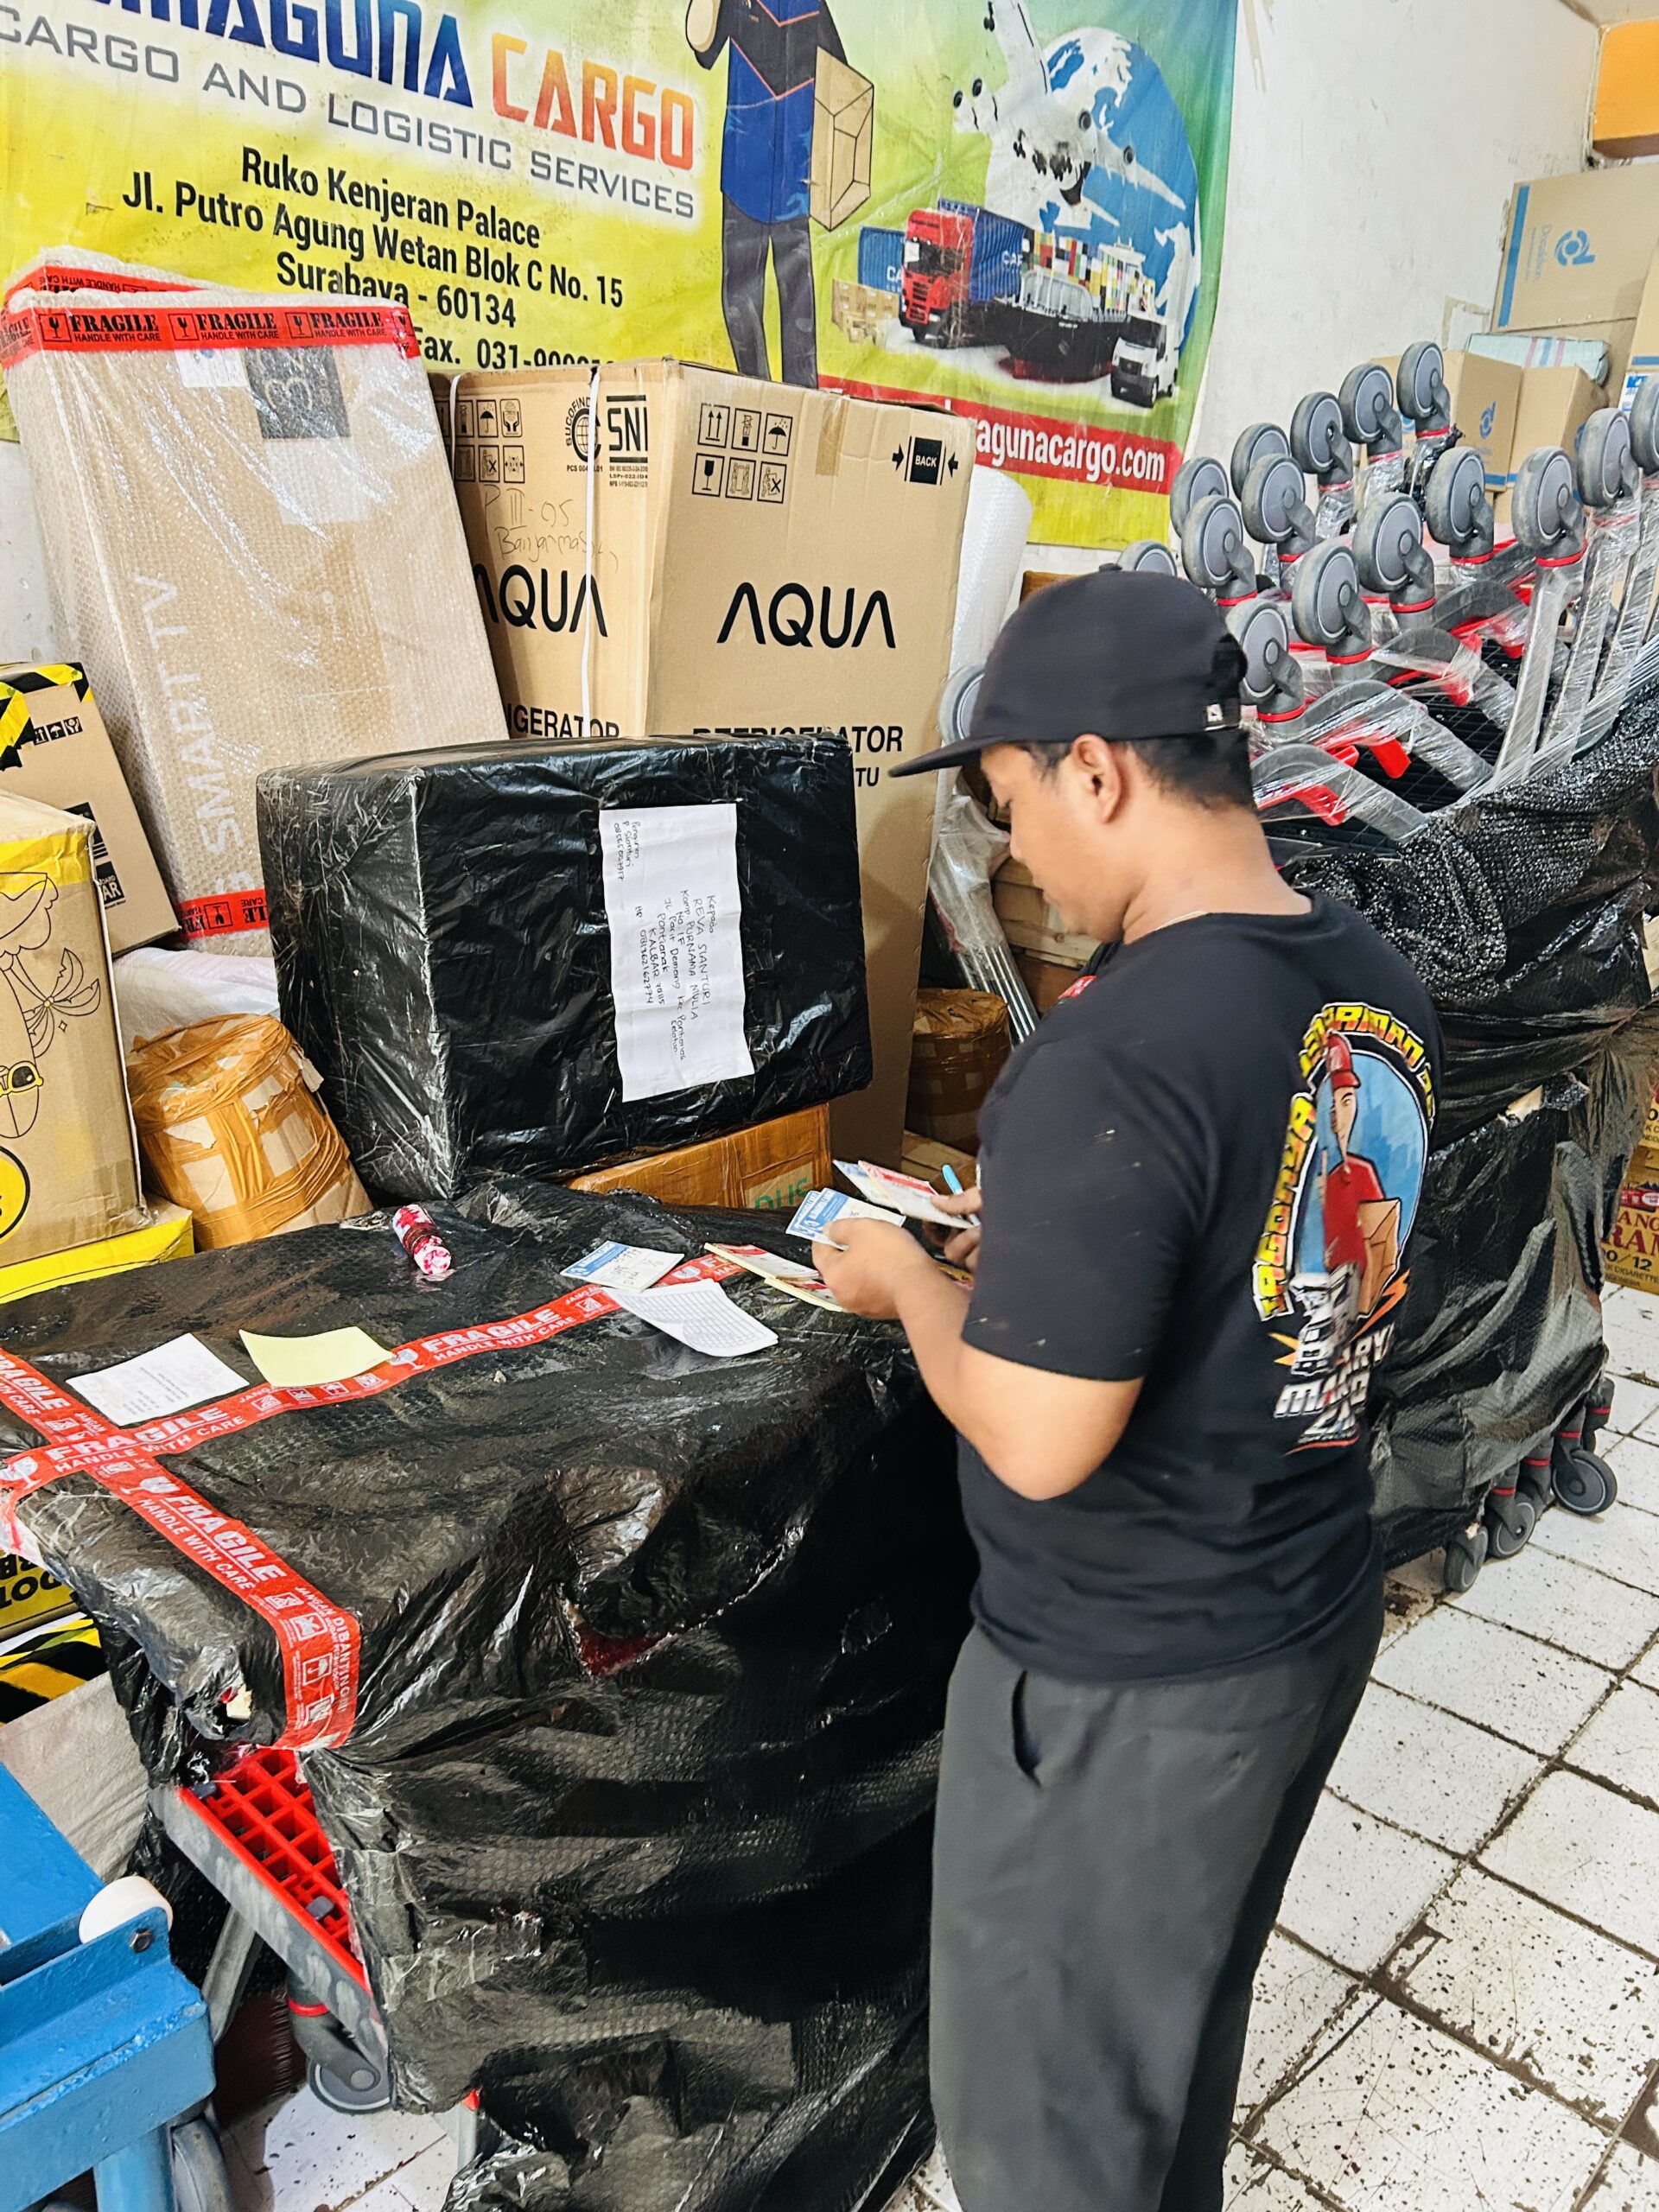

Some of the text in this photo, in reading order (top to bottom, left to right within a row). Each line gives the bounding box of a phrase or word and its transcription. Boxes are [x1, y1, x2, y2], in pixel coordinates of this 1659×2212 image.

[0, 5, 694, 219] CARGO AND LOGISTIC SERVICES
[492, 32, 695, 171] CARGO
[242, 146, 540, 249] Ruko Kenjeran Palace
[123, 171, 623, 308] Jl. Putro Agung Wetan Blok C No. 15
[69, 314, 159, 332] FRAGILE
[196, 314, 277, 329] FRAGILE
[312, 312, 384, 327] FRAGILE
[436, 284, 516, 328] 60134
[74, 334, 111, 342] HANDLE
[137, 333, 162, 342] CARE
[201, 330, 279, 340] HANDLE WITH CARE
[315, 329, 346, 338] HANDLE
[366, 328, 387, 337] CARE
[607, 407, 648, 451] SNI
[976, 419, 1165, 482] agunacargo.com
[915, 454, 938, 467] BACK
[135, 571, 188, 650] TV
[473, 563, 608, 637] AQUA
[716, 582, 896, 649] AQUA
[158, 661, 245, 855] SMART
[241, 898, 264, 907] CARE
[648, 928, 660, 978] KALBAR
[658, 913, 670, 972] Pontianak
[671, 948, 680, 989] Demang
[686, 920, 696, 976] PURNAMA
[693, 899, 711, 1005] REVA SIANTURI
[690, 984, 700, 1020] MULIA
[422, 1307, 561, 1352] FRAGILE
[434, 1315, 576, 1362] HANDLE WITH CARE
[0, 1354, 71, 1410] RAGILE
[9, 1395, 41, 1415] CARE
[45, 1407, 228, 1462] FRAGILE
[54, 1448, 138, 1472] HANDLE
[141, 1434, 192, 1452] WITH
[197, 1415, 246, 1436] CARE
[138, 1499, 256, 1589] HANDLE WITH CARE
[164, 1496, 288, 1582] FRAGILE
[295, 1586, 337, 1616] JANGAN
